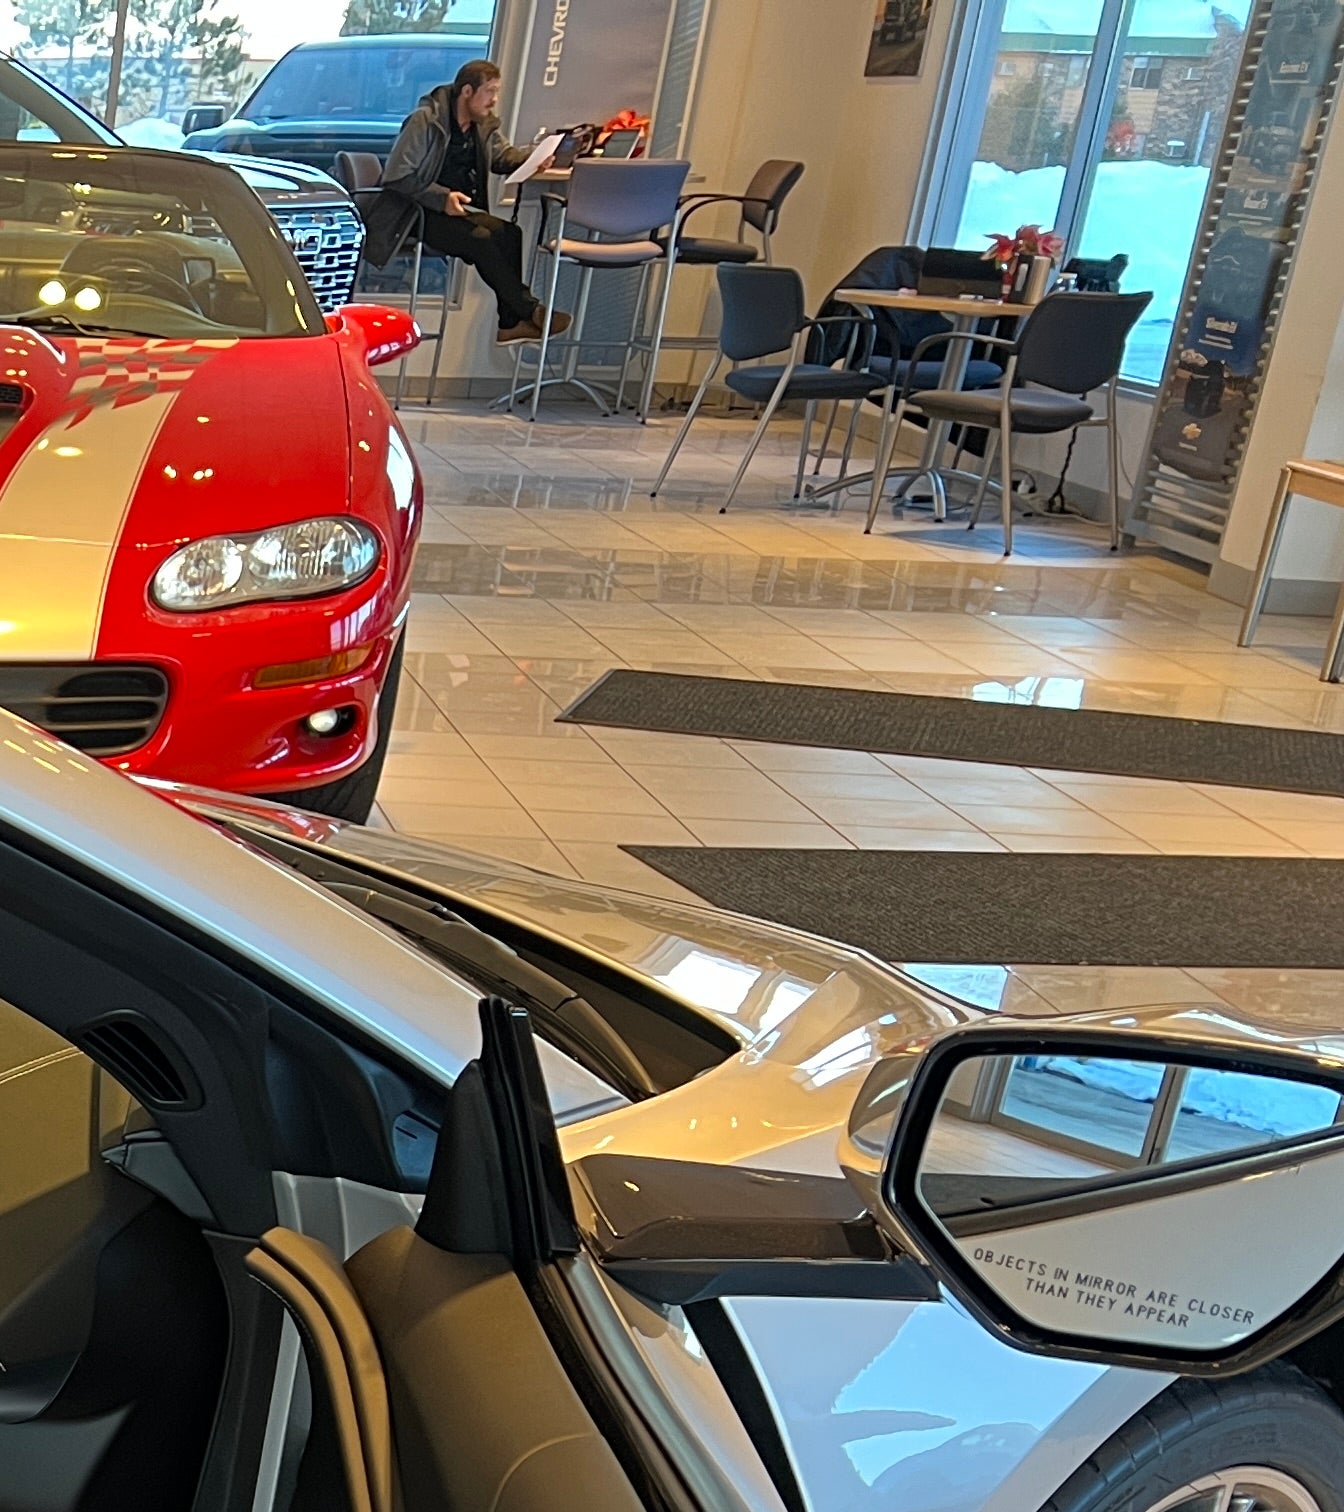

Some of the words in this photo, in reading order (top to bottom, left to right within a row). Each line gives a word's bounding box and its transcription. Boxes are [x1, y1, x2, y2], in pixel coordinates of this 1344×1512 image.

[279, 228, 323, 252] MC
[973, 1247, 1047, 1276] OBJECTS
[1053, 1266, 1069, 1282] IN
[1075, 1272, 1137, 1298] MIRROR
[1146, 1290, 1179, 1308] ARE
[1187, 1298, 1255, 1325] CLOSER
[1026, 1277, 1069, 1298] THAN
[1076, 1290, 1118, 1311] THEY
[1124, 1302, 1190, 1328] APPEAR
